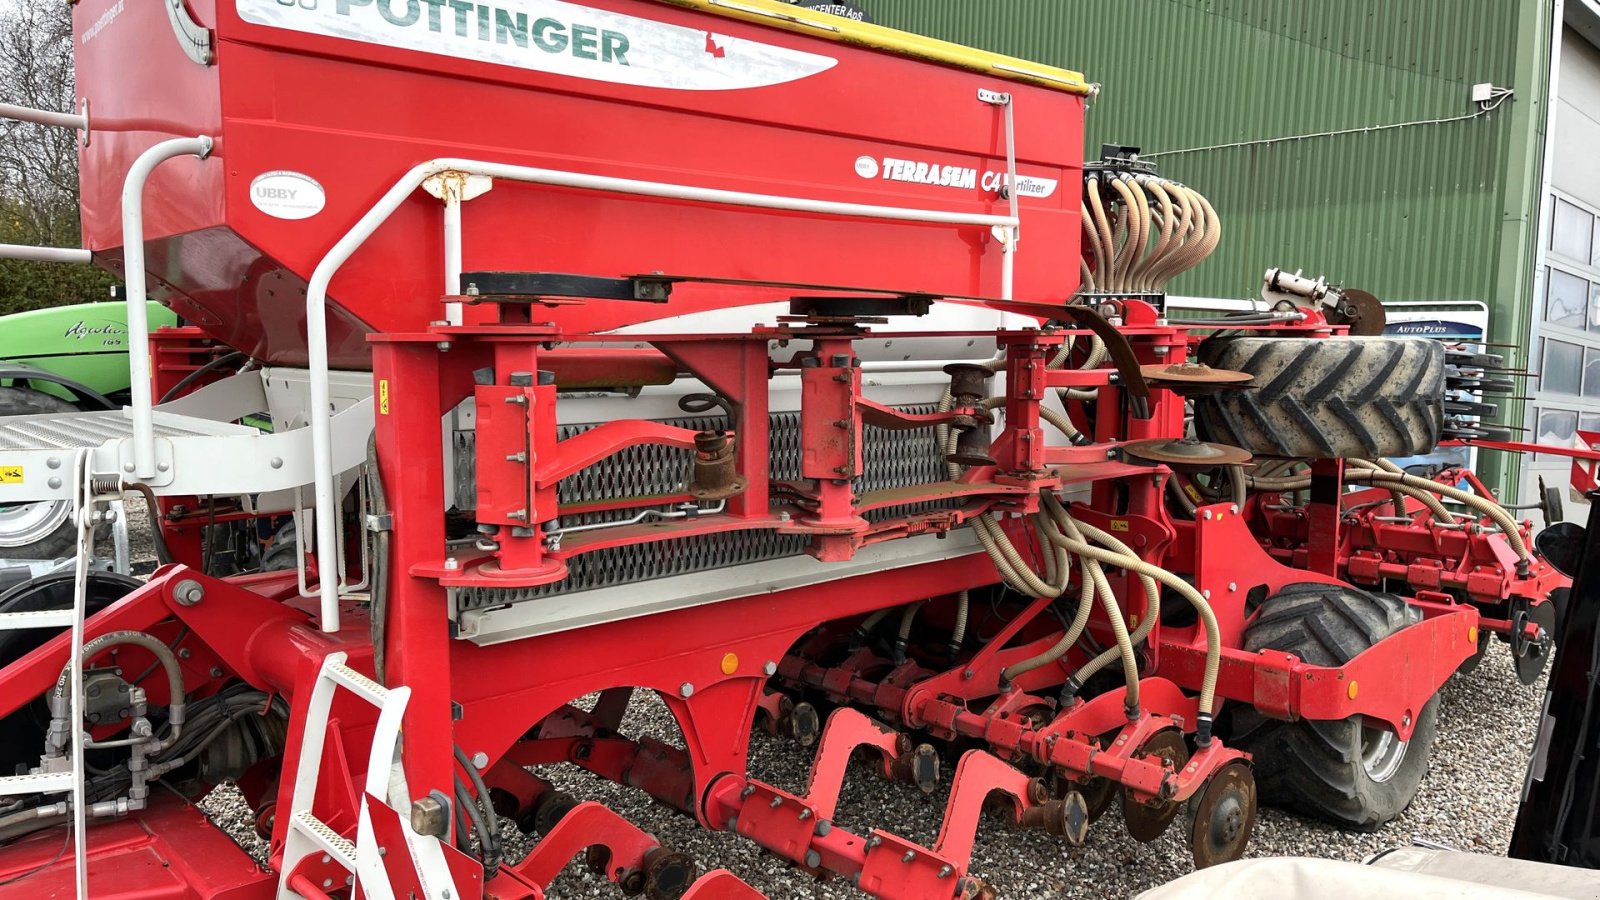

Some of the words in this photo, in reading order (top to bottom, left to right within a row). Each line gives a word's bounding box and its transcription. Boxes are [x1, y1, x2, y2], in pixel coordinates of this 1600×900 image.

[805, 4, 846, 16] NCENTER
[846, 7, 863, 21] ApS
[882, 158, 976, 189] TERRASEM
[981, 170, 1001, 192] C4
[1016, 180, 1046, 194] rtilizer
[256, 187, 297, 200] UBBY
